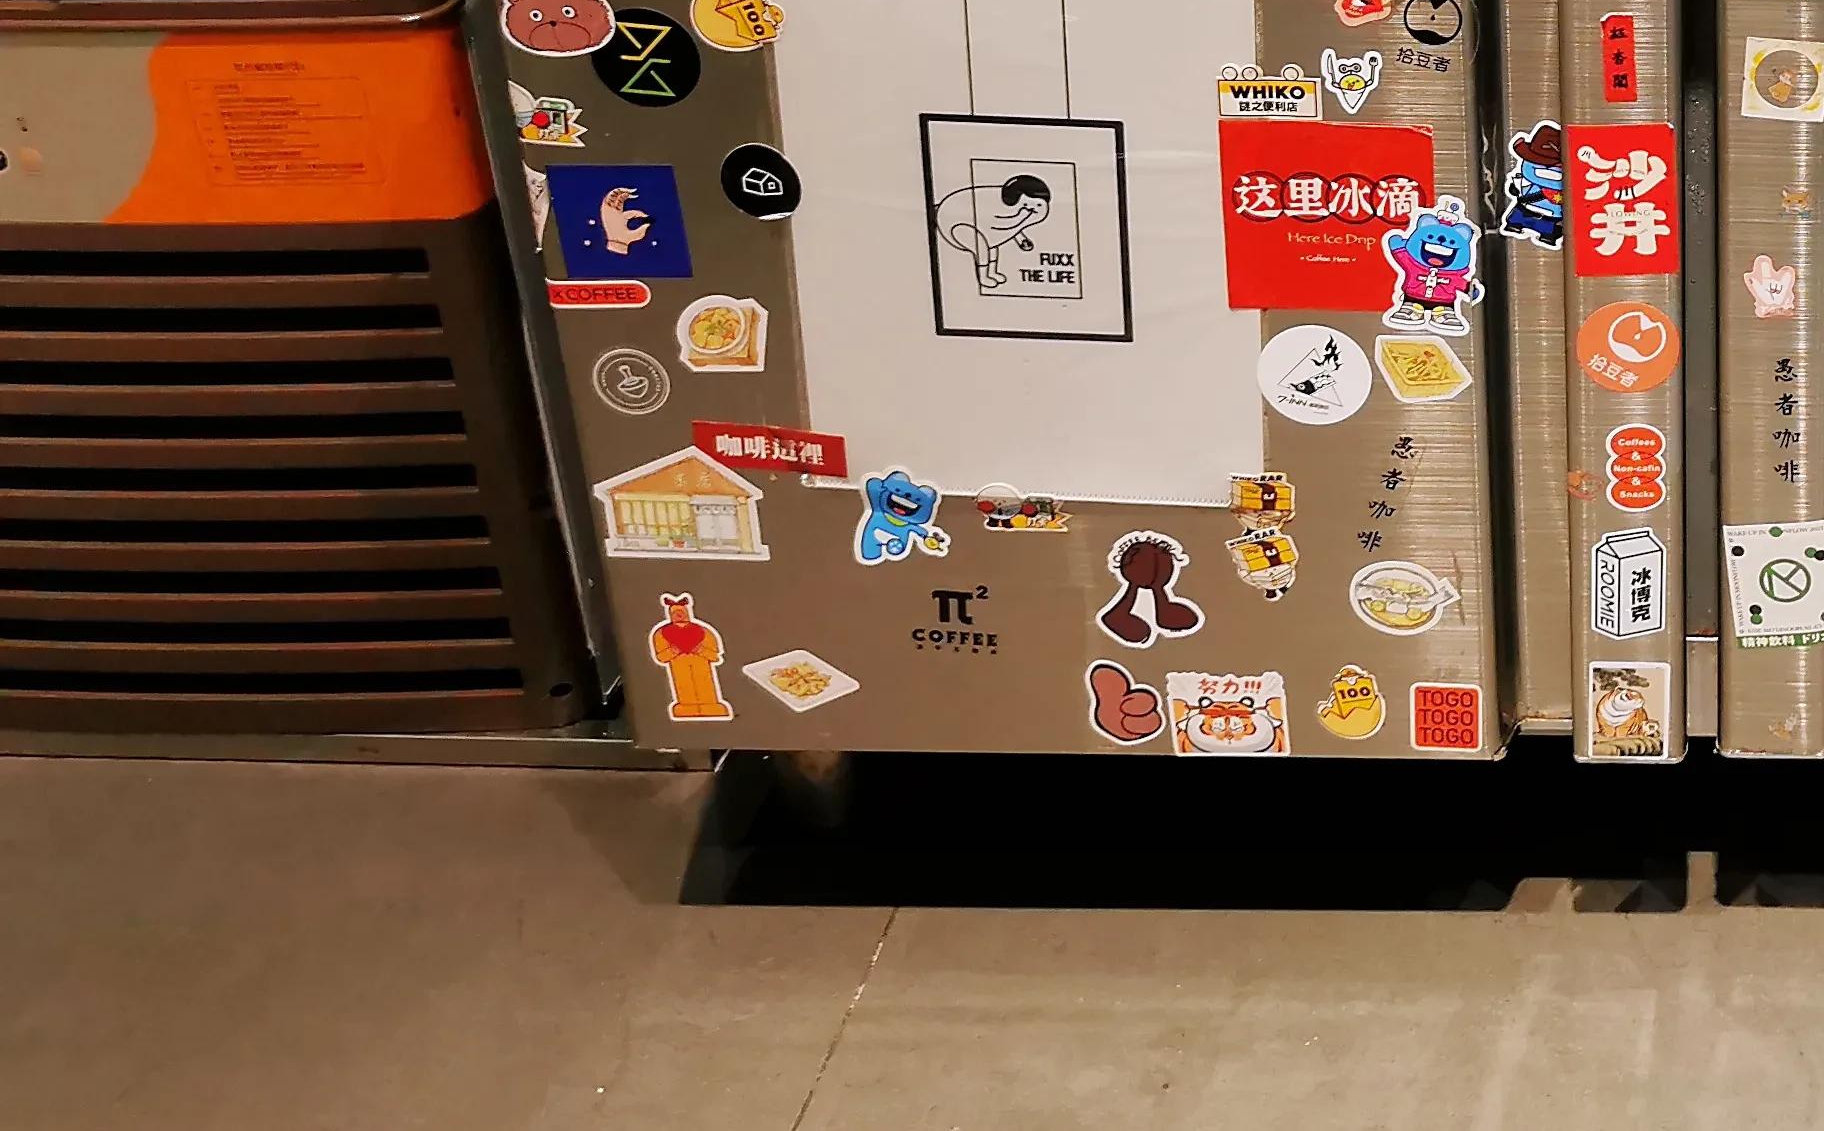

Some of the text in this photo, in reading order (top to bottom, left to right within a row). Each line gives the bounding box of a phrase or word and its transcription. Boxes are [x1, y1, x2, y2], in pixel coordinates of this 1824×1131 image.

[740, 1, 764, 37] 100
[1230, 86, 1305, 100] WHIKO
[1234, 176, 1419, 218] 这里冰滴
[1577, 146, 1671, 256] 沙井
[1287, 232, 1376, 251] Here Ice Drip
[1019, 269, 1075, 283] THE LIFE
[566, 288, 637, 300] COFFEE
[1588, 353, 1639, 387] 拾豆者
[1600, 559, 1615, 629] ROOMIE
[1631, 567, 1651, 622] 冰博克
[911, 627, 998, 647] COFFEE
[1338, 686, 1371, 700] 100
[1419, 690, 1473, 707] TOGO
[1419, 709, 1473, 726] TOGO
[1419, 727, 1473, 745] TOGO
